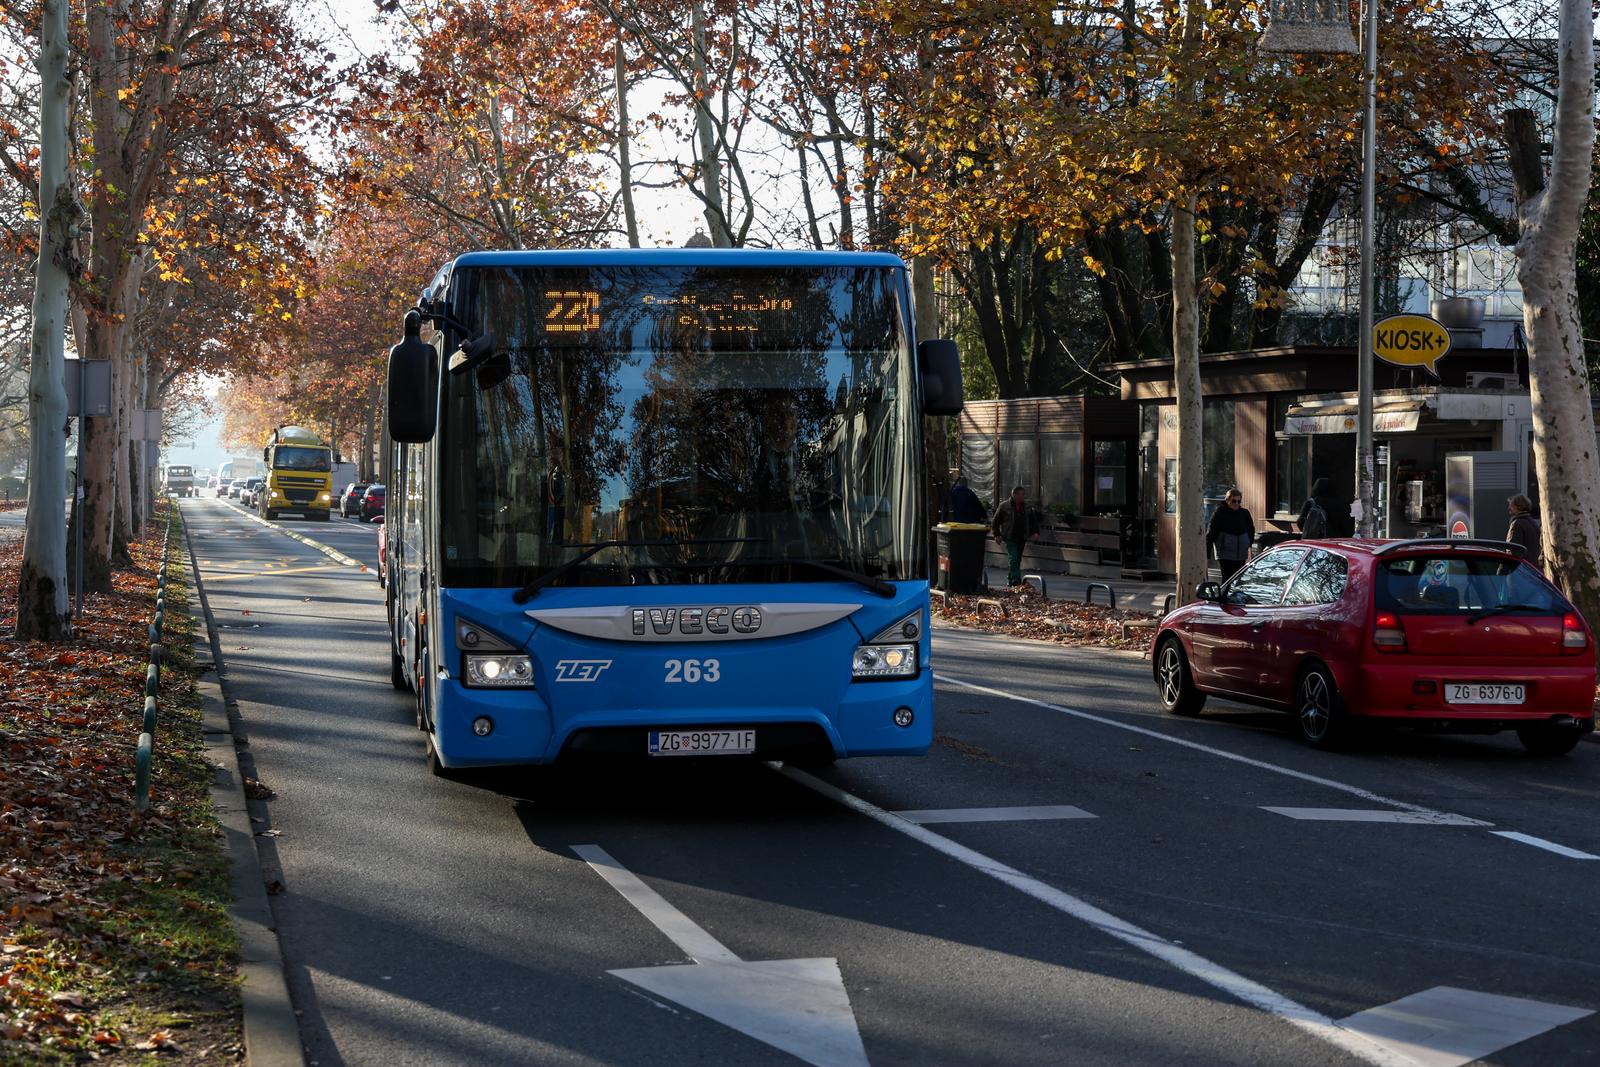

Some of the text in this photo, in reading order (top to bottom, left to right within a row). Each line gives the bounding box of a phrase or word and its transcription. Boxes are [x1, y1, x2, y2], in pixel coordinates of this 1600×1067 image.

[1376, 329, 1445, 350] KIOSK+
[632, 606, 763, 635] IVECO
[555, 659, 612, 683] ZET
[664, 659, 721, 683] 263
[1454, 685, 1470, 699] ZG
[660, 733, 680, 750] ZG
